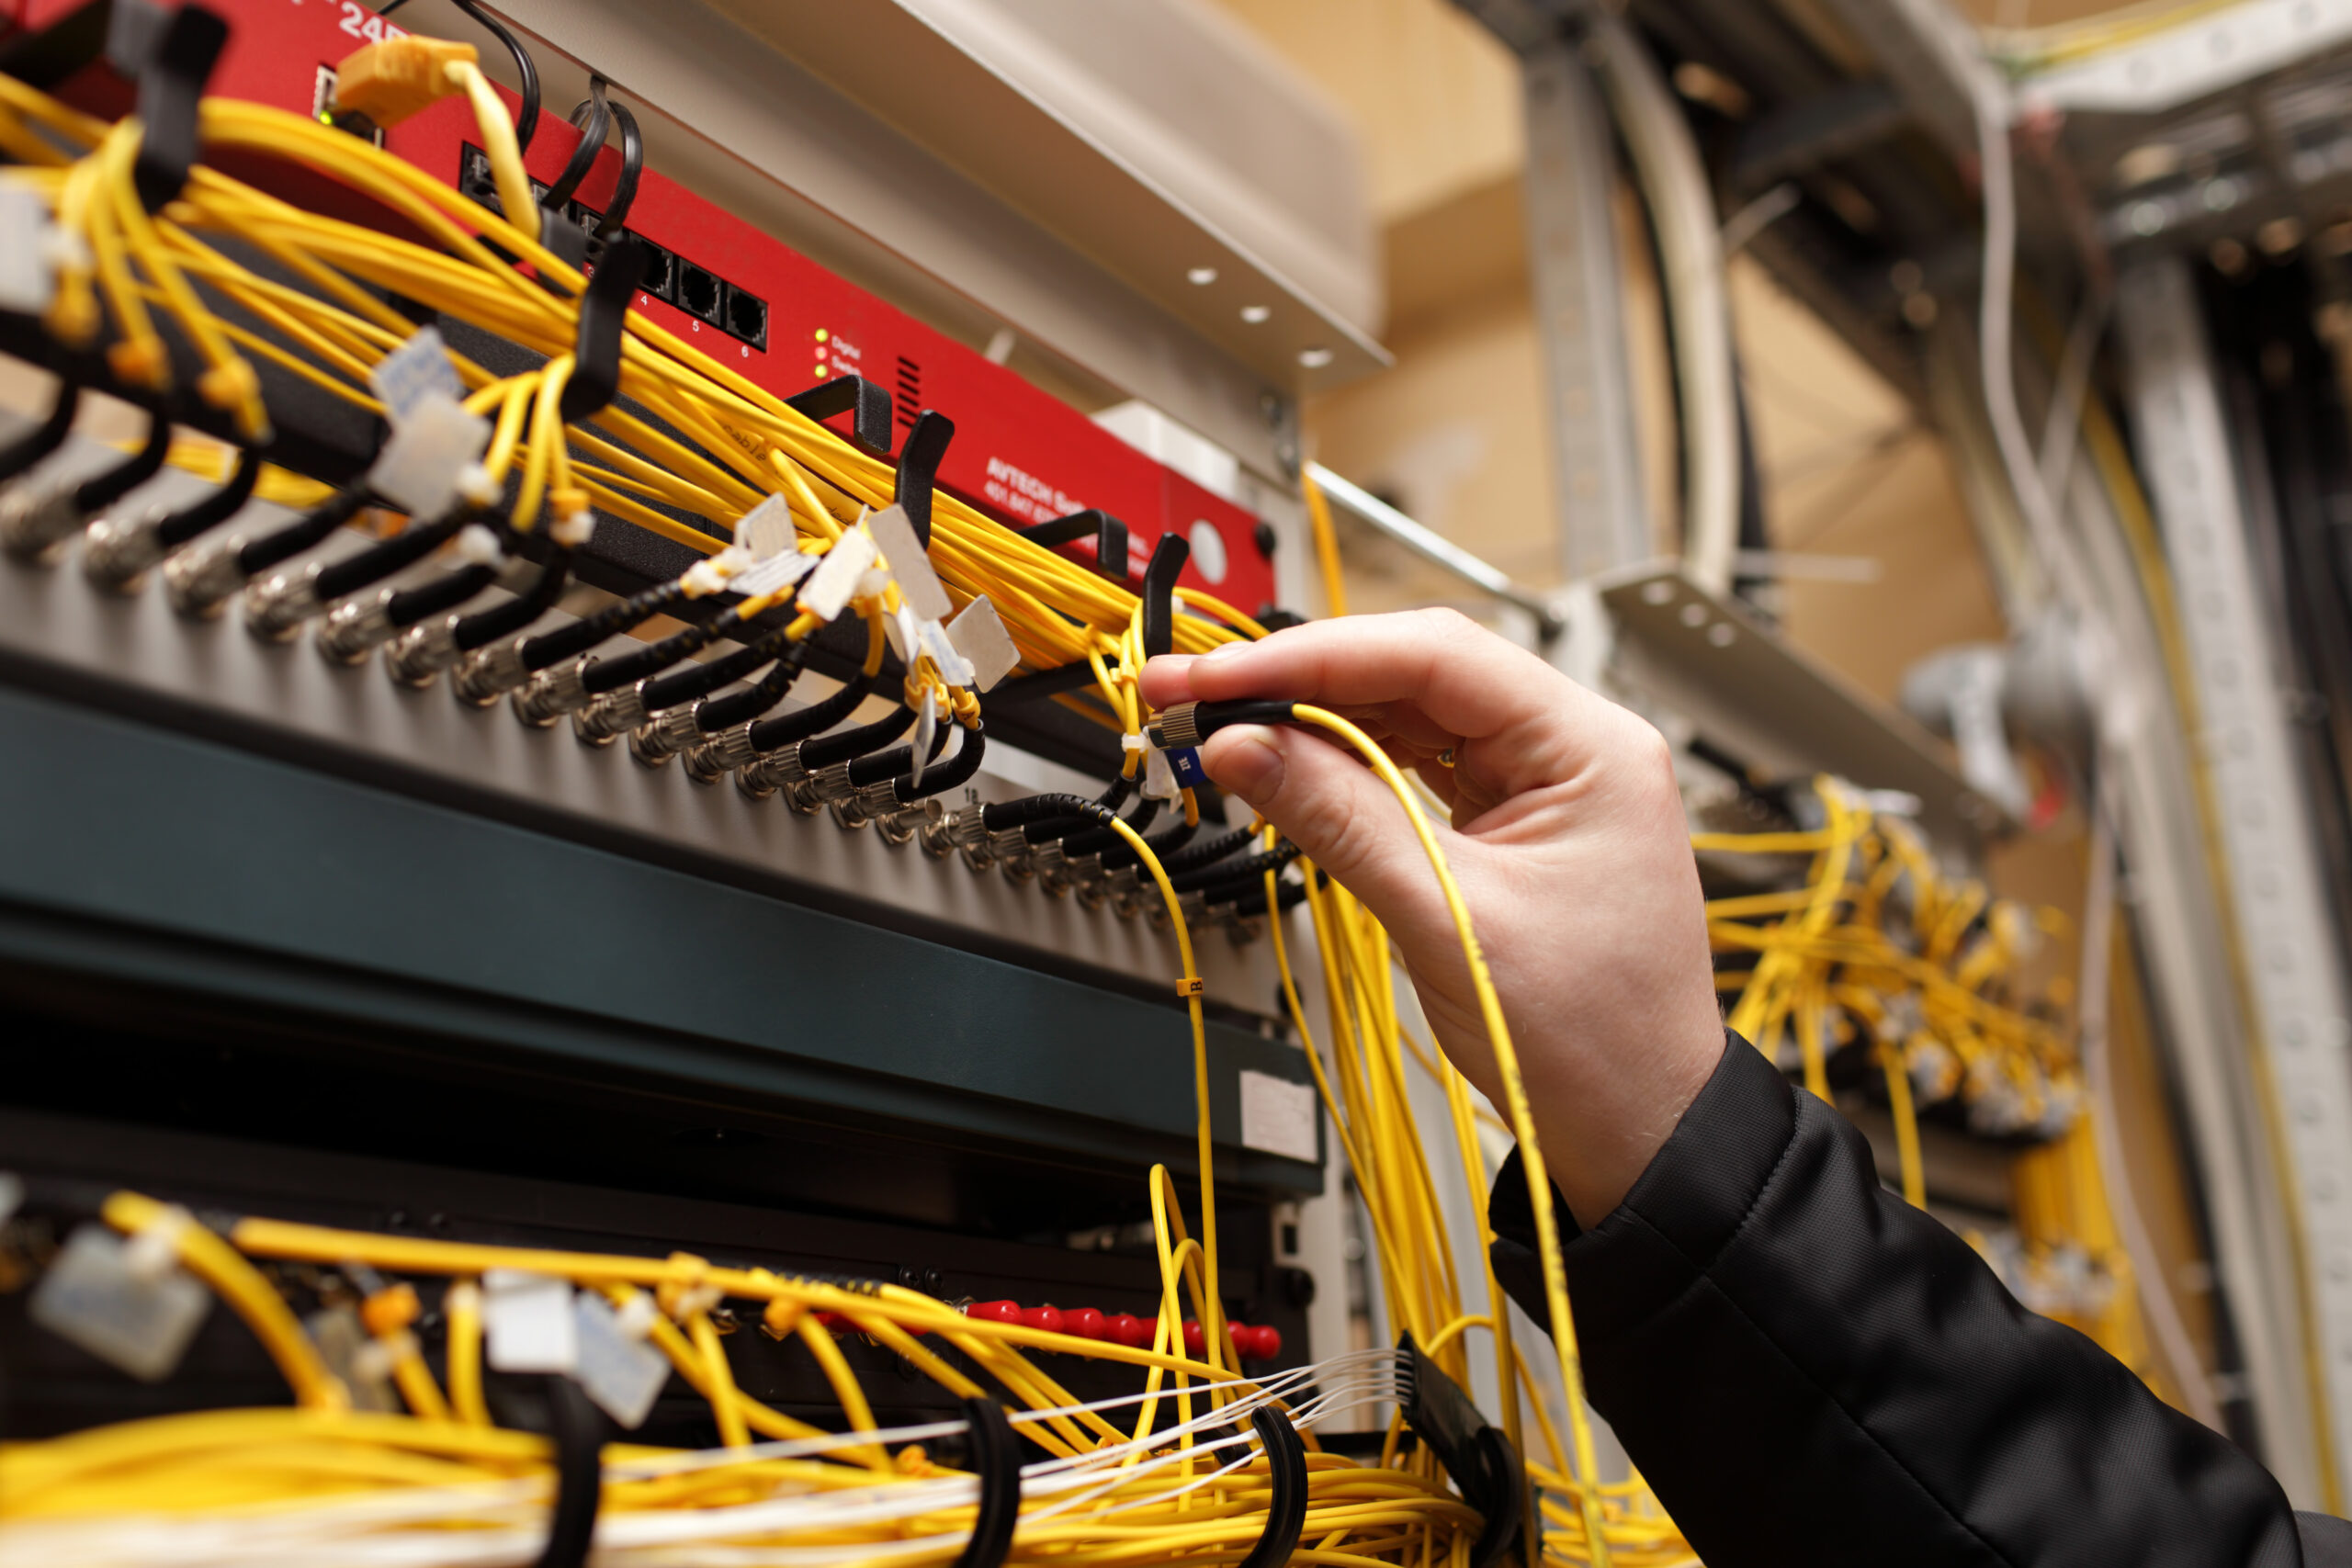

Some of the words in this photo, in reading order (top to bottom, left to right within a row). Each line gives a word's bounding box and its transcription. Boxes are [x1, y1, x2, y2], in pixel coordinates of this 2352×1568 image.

[640, 295, 648, 306] 4
[692, 320, 699, 332] 5
[741, 345, 749, 358] 6
[986, 456, 1054, 506] AVTECH
[1190, 981, 1203, 993] B
